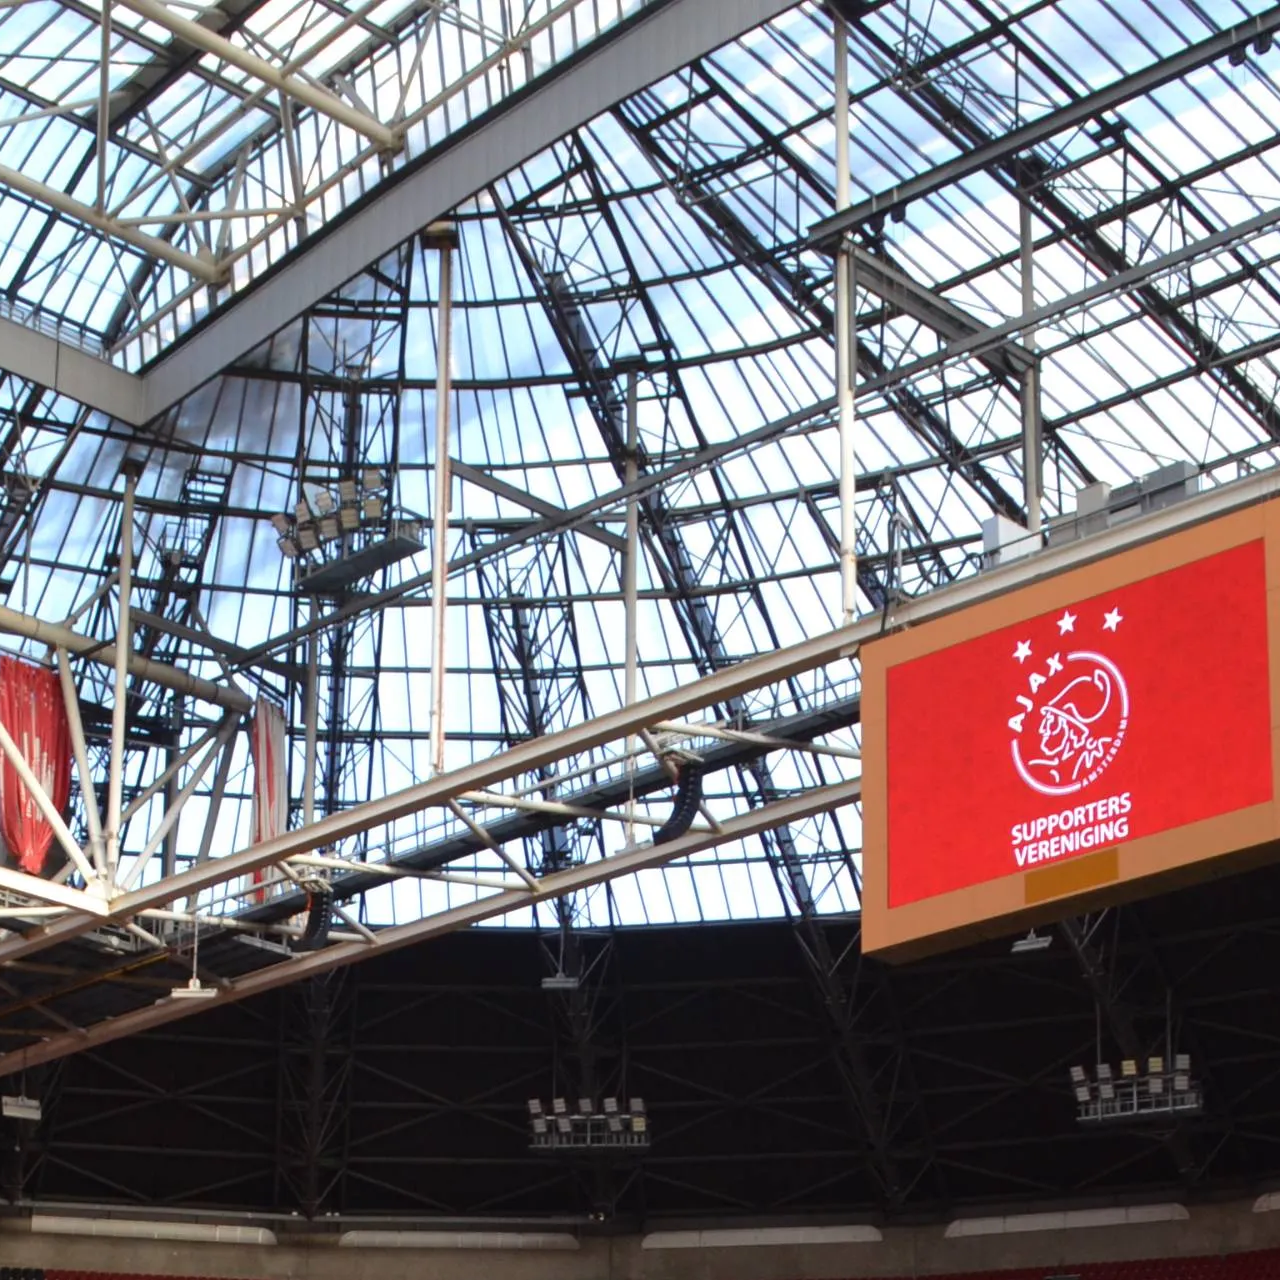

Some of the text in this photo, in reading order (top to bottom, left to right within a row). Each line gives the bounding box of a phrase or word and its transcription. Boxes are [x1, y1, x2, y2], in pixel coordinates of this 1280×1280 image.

[1008, 652, 1063, 733] AJAX
[1081, 718, 1128, 788] AMSTERDAM
[1011, 792, 1132, 845] SUPPORTERS
[1013, 817, 1129, 867] VERENIGING
